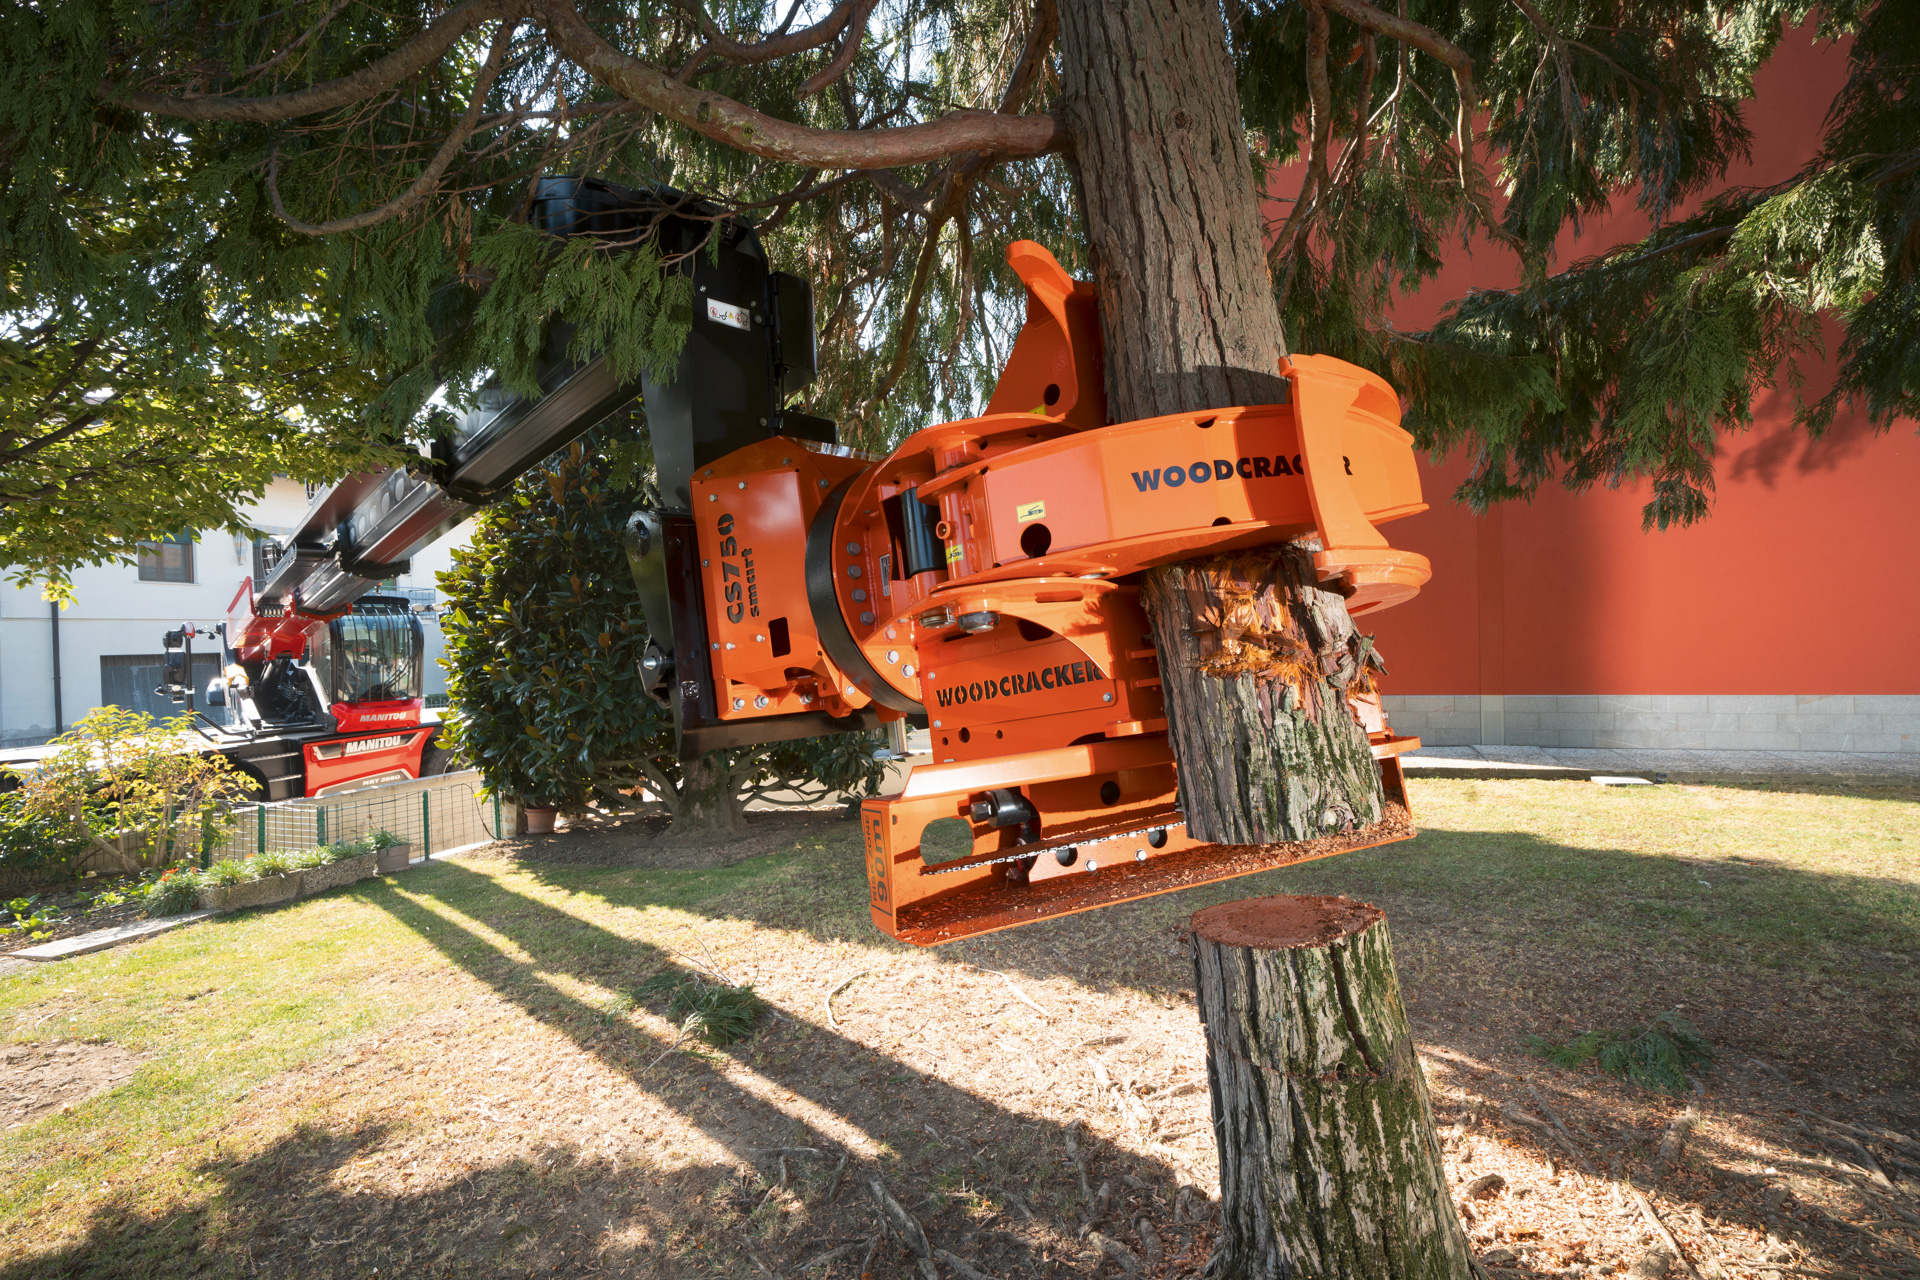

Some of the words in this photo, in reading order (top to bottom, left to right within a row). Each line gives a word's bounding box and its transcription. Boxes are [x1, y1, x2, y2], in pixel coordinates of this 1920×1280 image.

[1131, 453, 1353, 492] WOODCRACR
[717, 513, 745, 624] CS750
[741, 548, 760, 618] smart
[936, 660, 1103, 707] WOODCRACKER
[360, 712, 406, 722] MANITOU
[346, 735, 401, 753] MANITOU
[363, 778, 379, 786] MRT
[864, 814, 873, 858] ZONE
[872, 819, 888, 903] 90m
[869, 864, 878, 902] RISK
